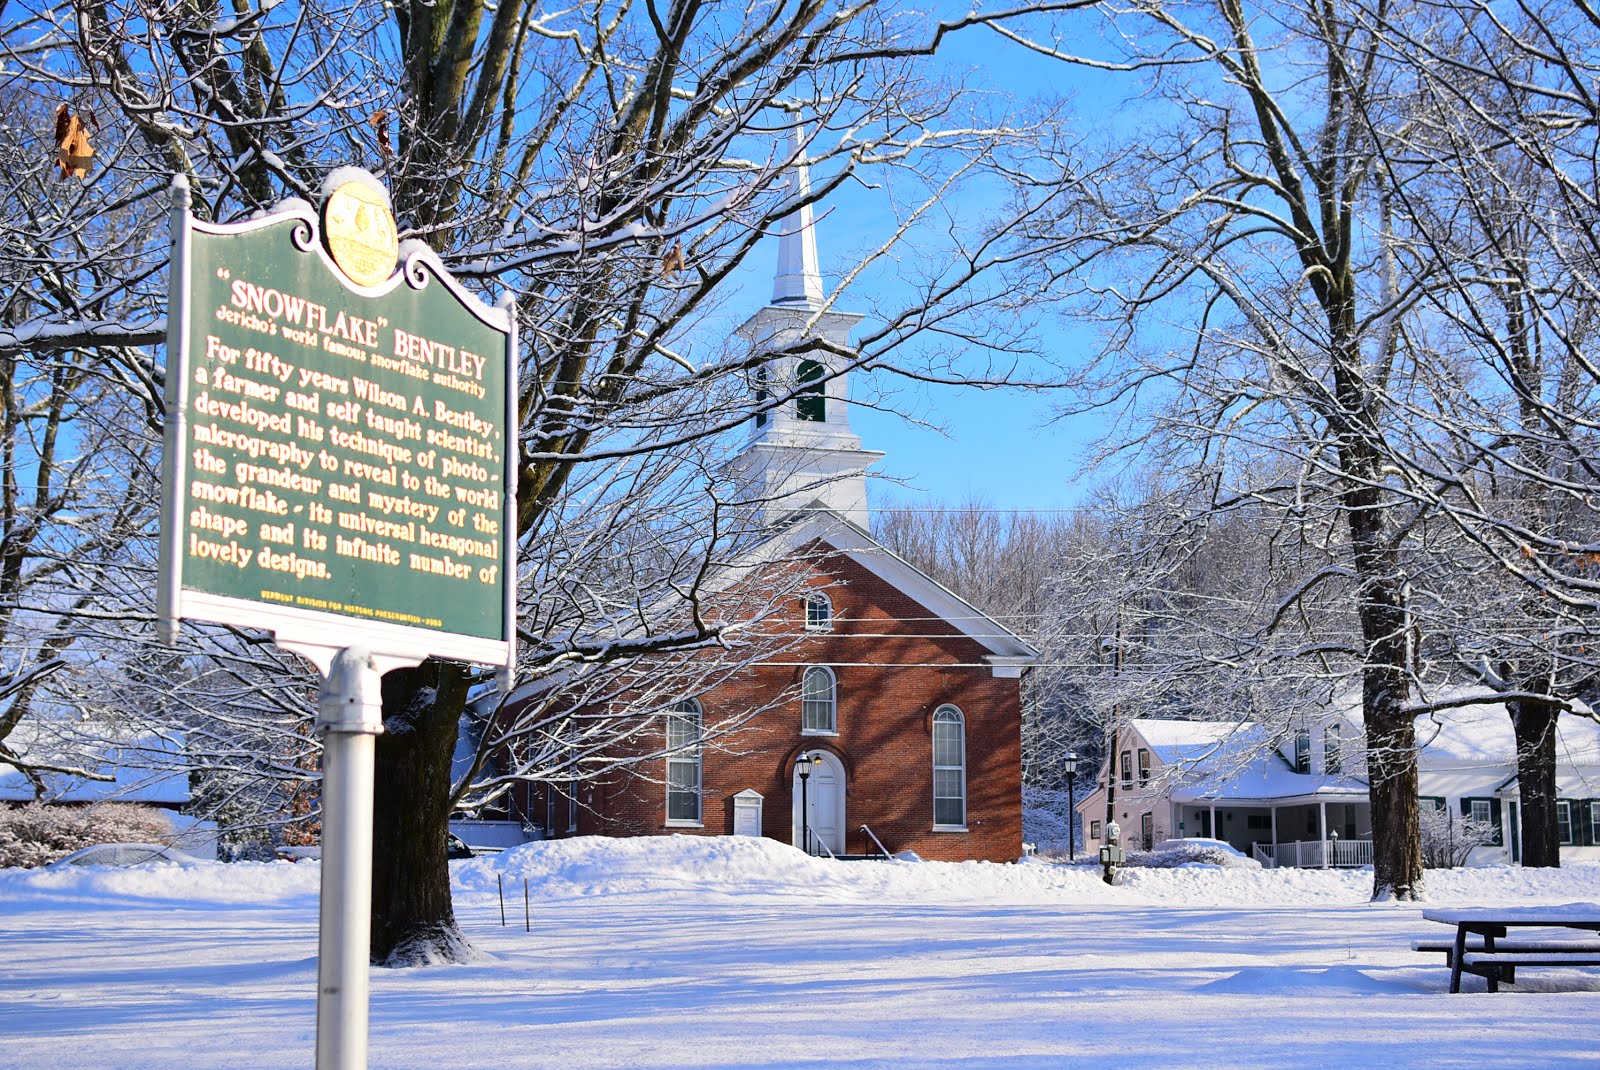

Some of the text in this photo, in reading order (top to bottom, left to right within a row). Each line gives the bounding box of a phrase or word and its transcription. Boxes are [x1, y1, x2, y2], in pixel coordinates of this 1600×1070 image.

[206, 335, 241, 365] For
[242, 347, 294, 383] fifty
[298, 368, 349, 396] years
[351, 376, 408, 411] Wilson
[412, 395, 430, 418] A.
[281, 325, 318, 347] world
[323, 337, 367, 363] famous
[370, 353, 430, 381] snowflake
[432, 372, 487, 400] authority
[394, 329, 487, 380] BENTLEY
[194, 366, 500, 463] a farmer and self taught scientist,
[194, 396, 292, 435] developed
[297, 415, 324, 442] his
[329, 424, 412, 465] technique
[416, 449, 436, 470] of
[193, 447, 498, 534] the grandeur and mystery of the
[194, 424, 499, 512] micrography to reveal to the world
[189, 532, 332, 581] lovely designs.
[190, 505, 498, 584] shape and its infinite number of
[191, 480, 288, 516] snowflake
[309, 501, 332, 525] its
[338, 512, 415, 542] universal
[419, 526, 498, 560] hexagonal
